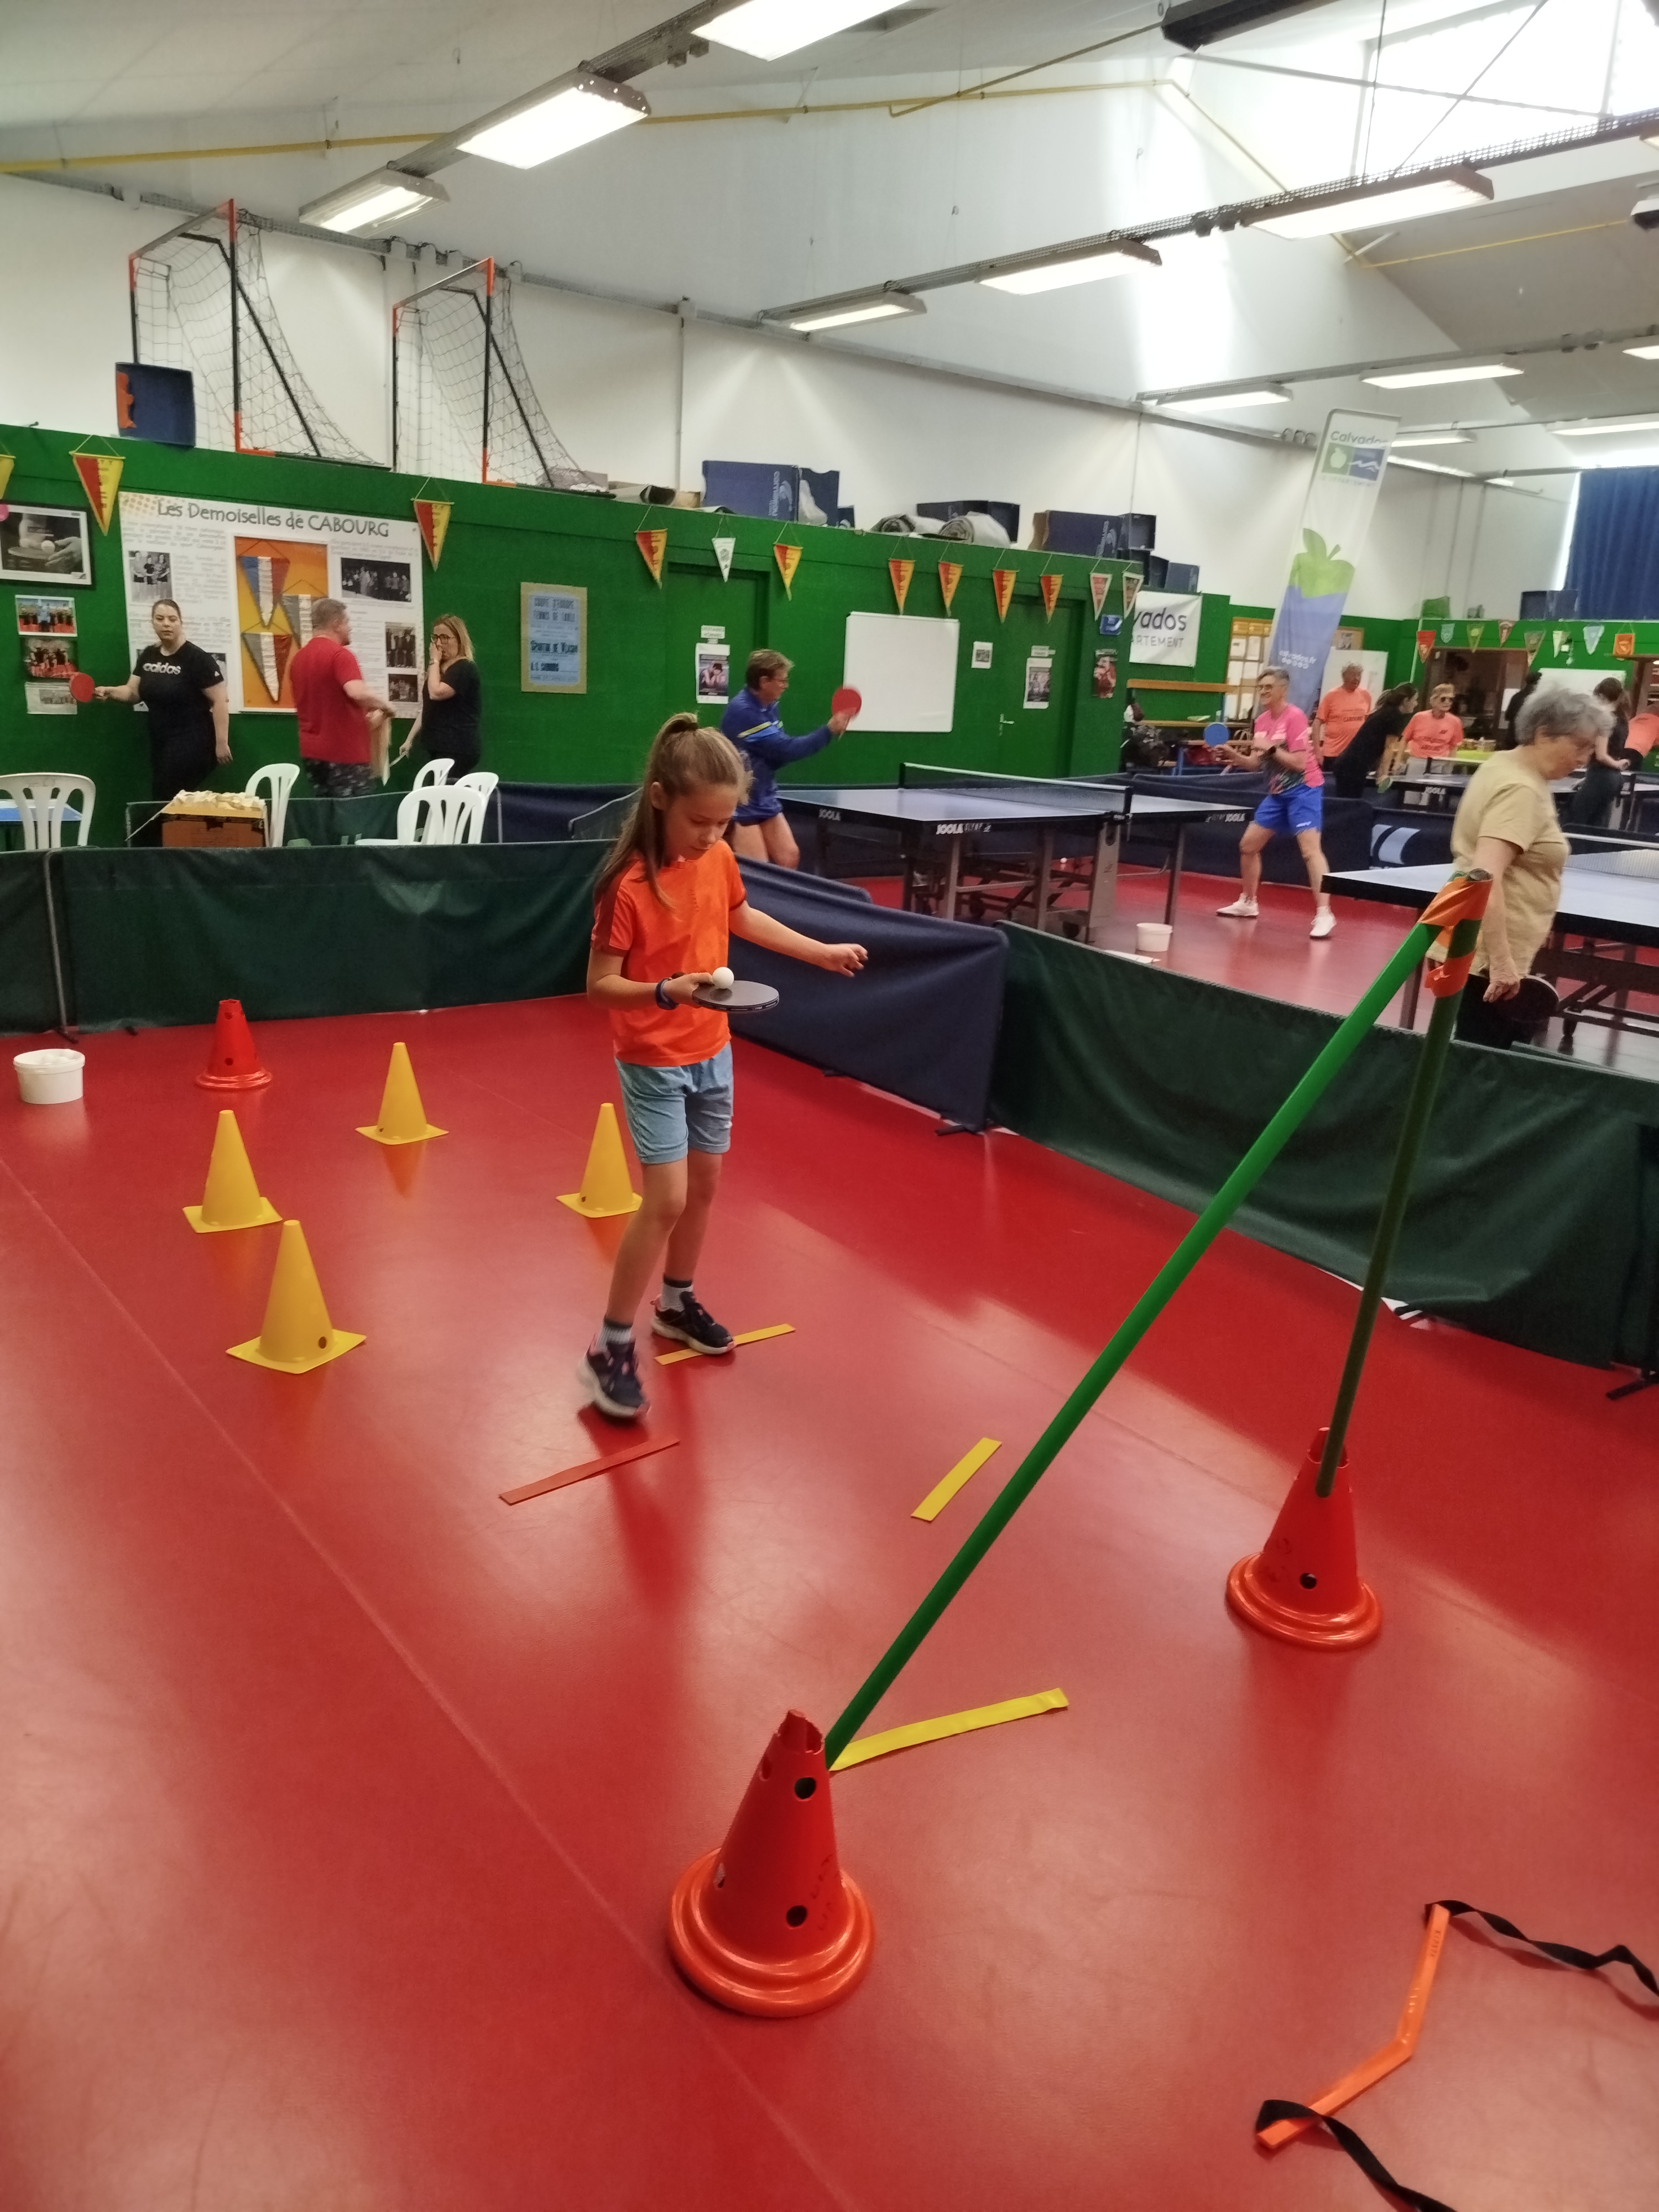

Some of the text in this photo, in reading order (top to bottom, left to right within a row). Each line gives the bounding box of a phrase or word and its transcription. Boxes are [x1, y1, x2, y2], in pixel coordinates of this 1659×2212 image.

[158, 499, 182, 517] Les
[188, 502, 281, 526] Demoiselles
[307, 514, 389, 537] CABOURG
[1131, 634, 1184, 648] RTEMENT
[143, 662, 181, 675] adidas
[818, 808, 841, 821] JOOLA
[936, 823, 963, 834] JOOLA
